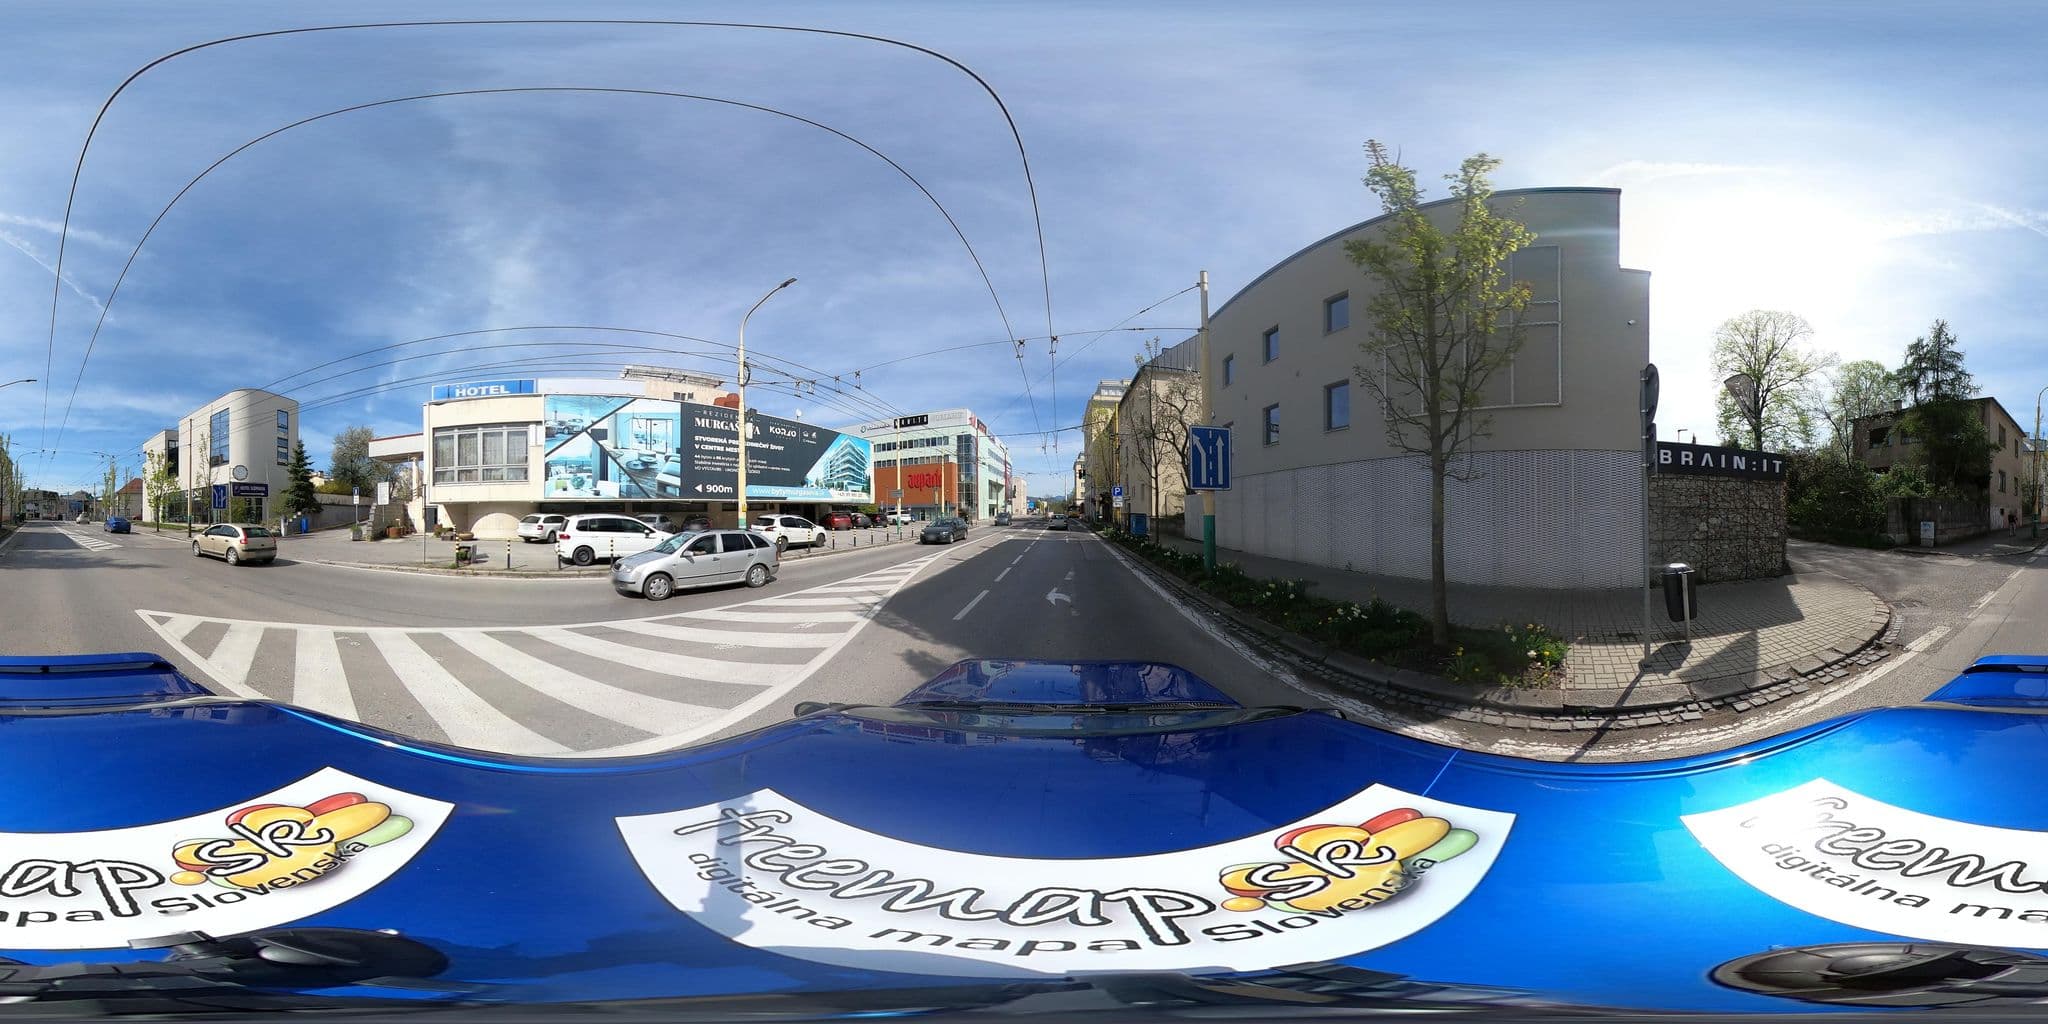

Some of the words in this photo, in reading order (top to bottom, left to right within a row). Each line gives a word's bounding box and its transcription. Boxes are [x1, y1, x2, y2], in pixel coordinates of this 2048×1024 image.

[455, 385, 510, 397] HOTEL
[694, 417, 760, 435] MURGAŠA
[706, 484, 733, 493] 900m
[0, 910, 104, 927] pa
[151, 841, 369, 914] Slovenska
[1761, 843, 1930, 908] digitálna
[688, 853, 853, 930] digitálna
[868, 927, 1142, 956] mapa
[1201, 857, 1438, 942] Slovenska
